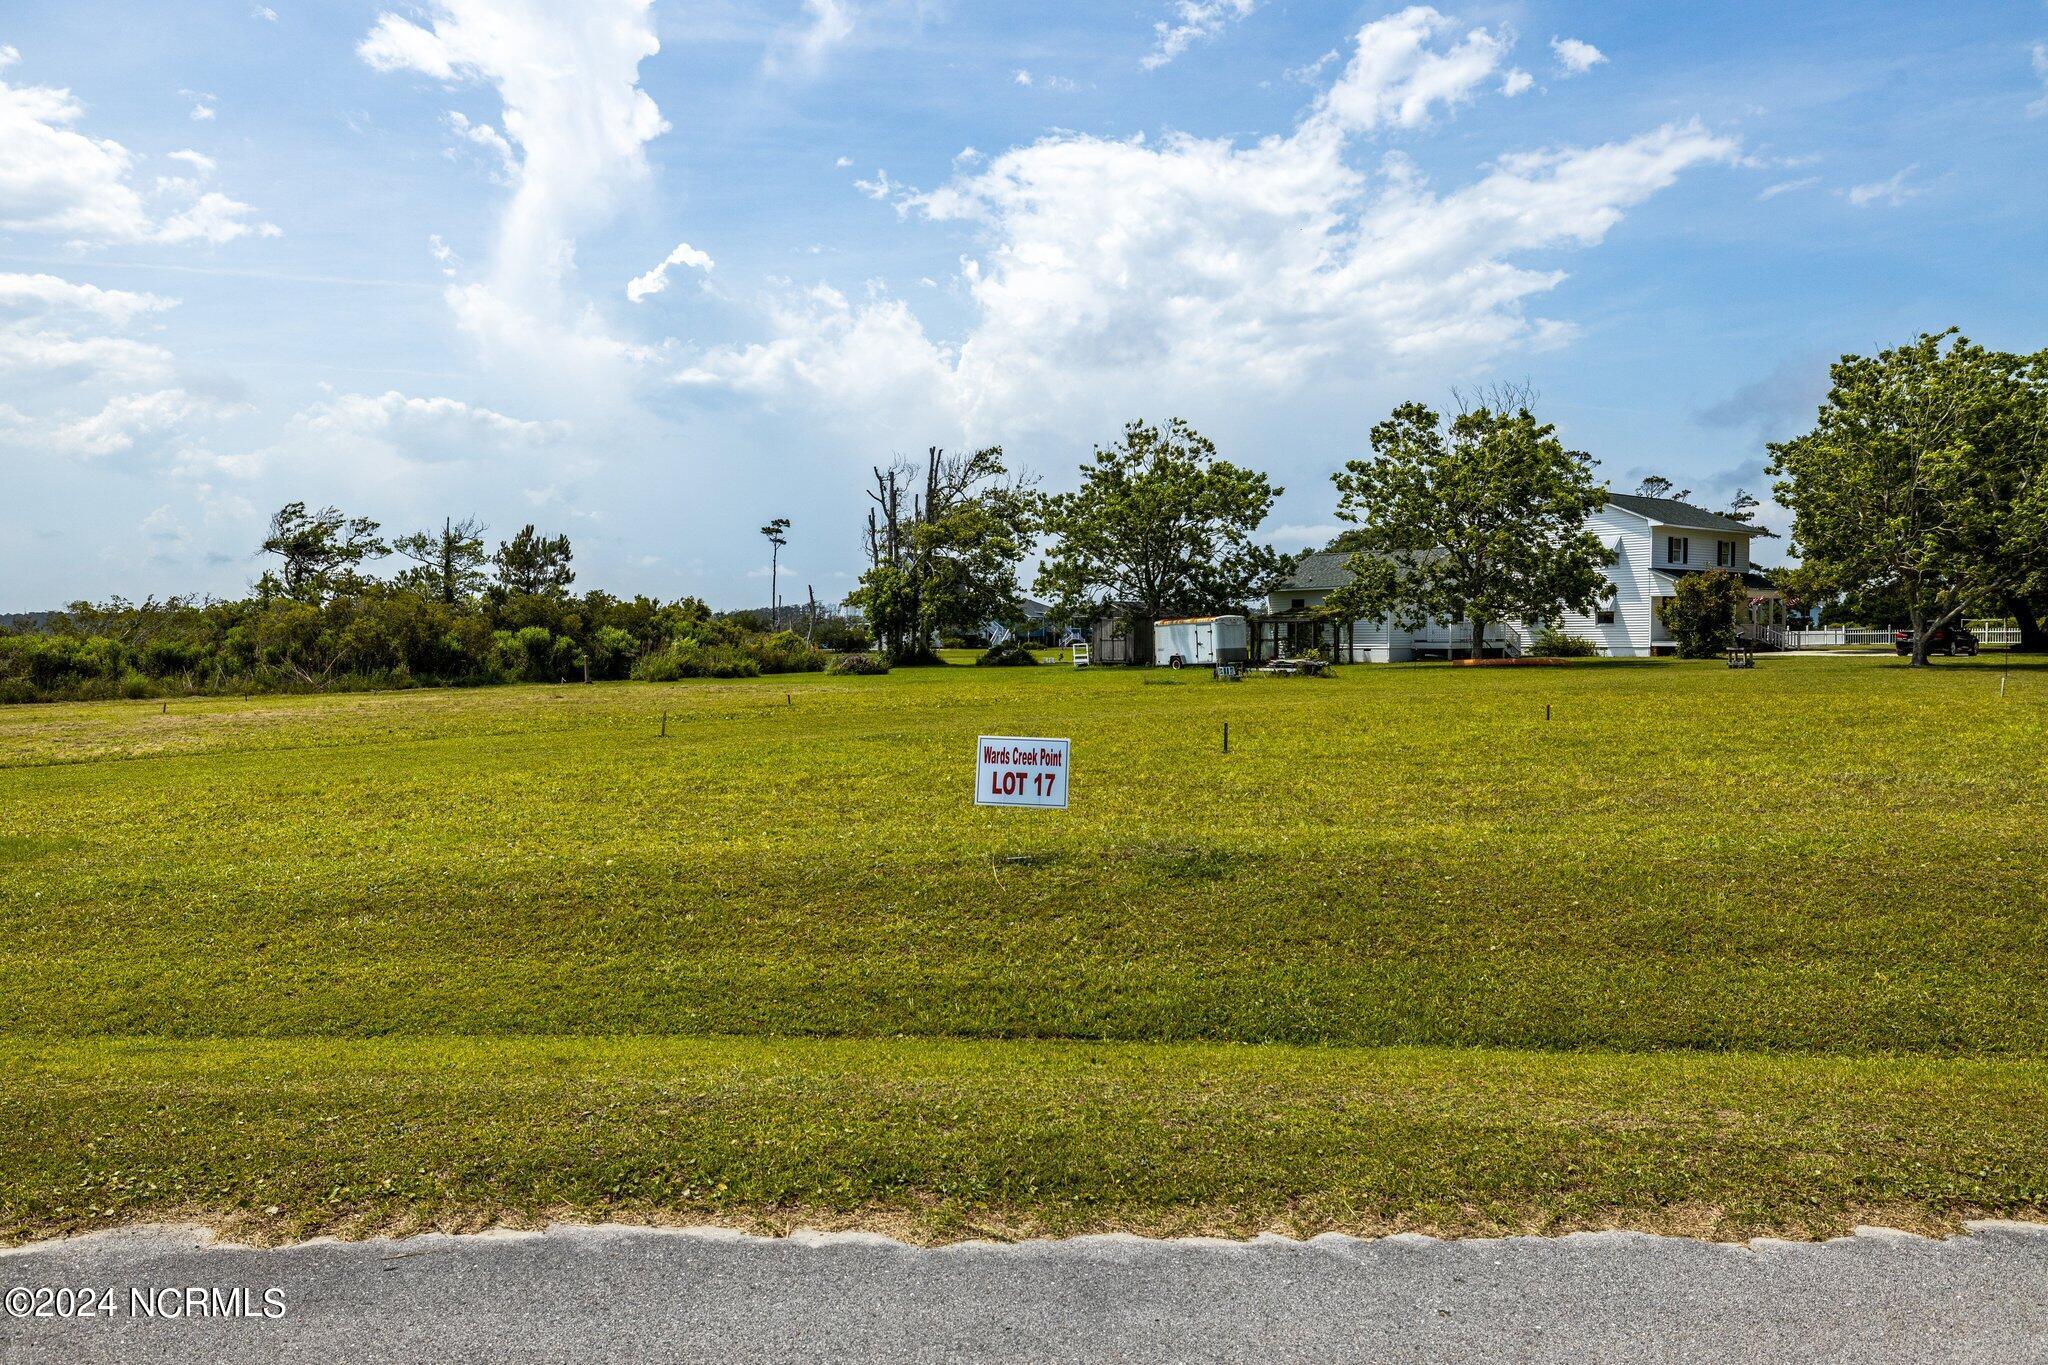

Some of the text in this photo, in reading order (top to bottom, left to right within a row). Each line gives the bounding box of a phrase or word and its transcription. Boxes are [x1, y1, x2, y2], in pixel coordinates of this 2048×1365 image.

[984, 746, 1062, 767] Wards Creek Point
[992, 771, 1056, 796] LOT 17
